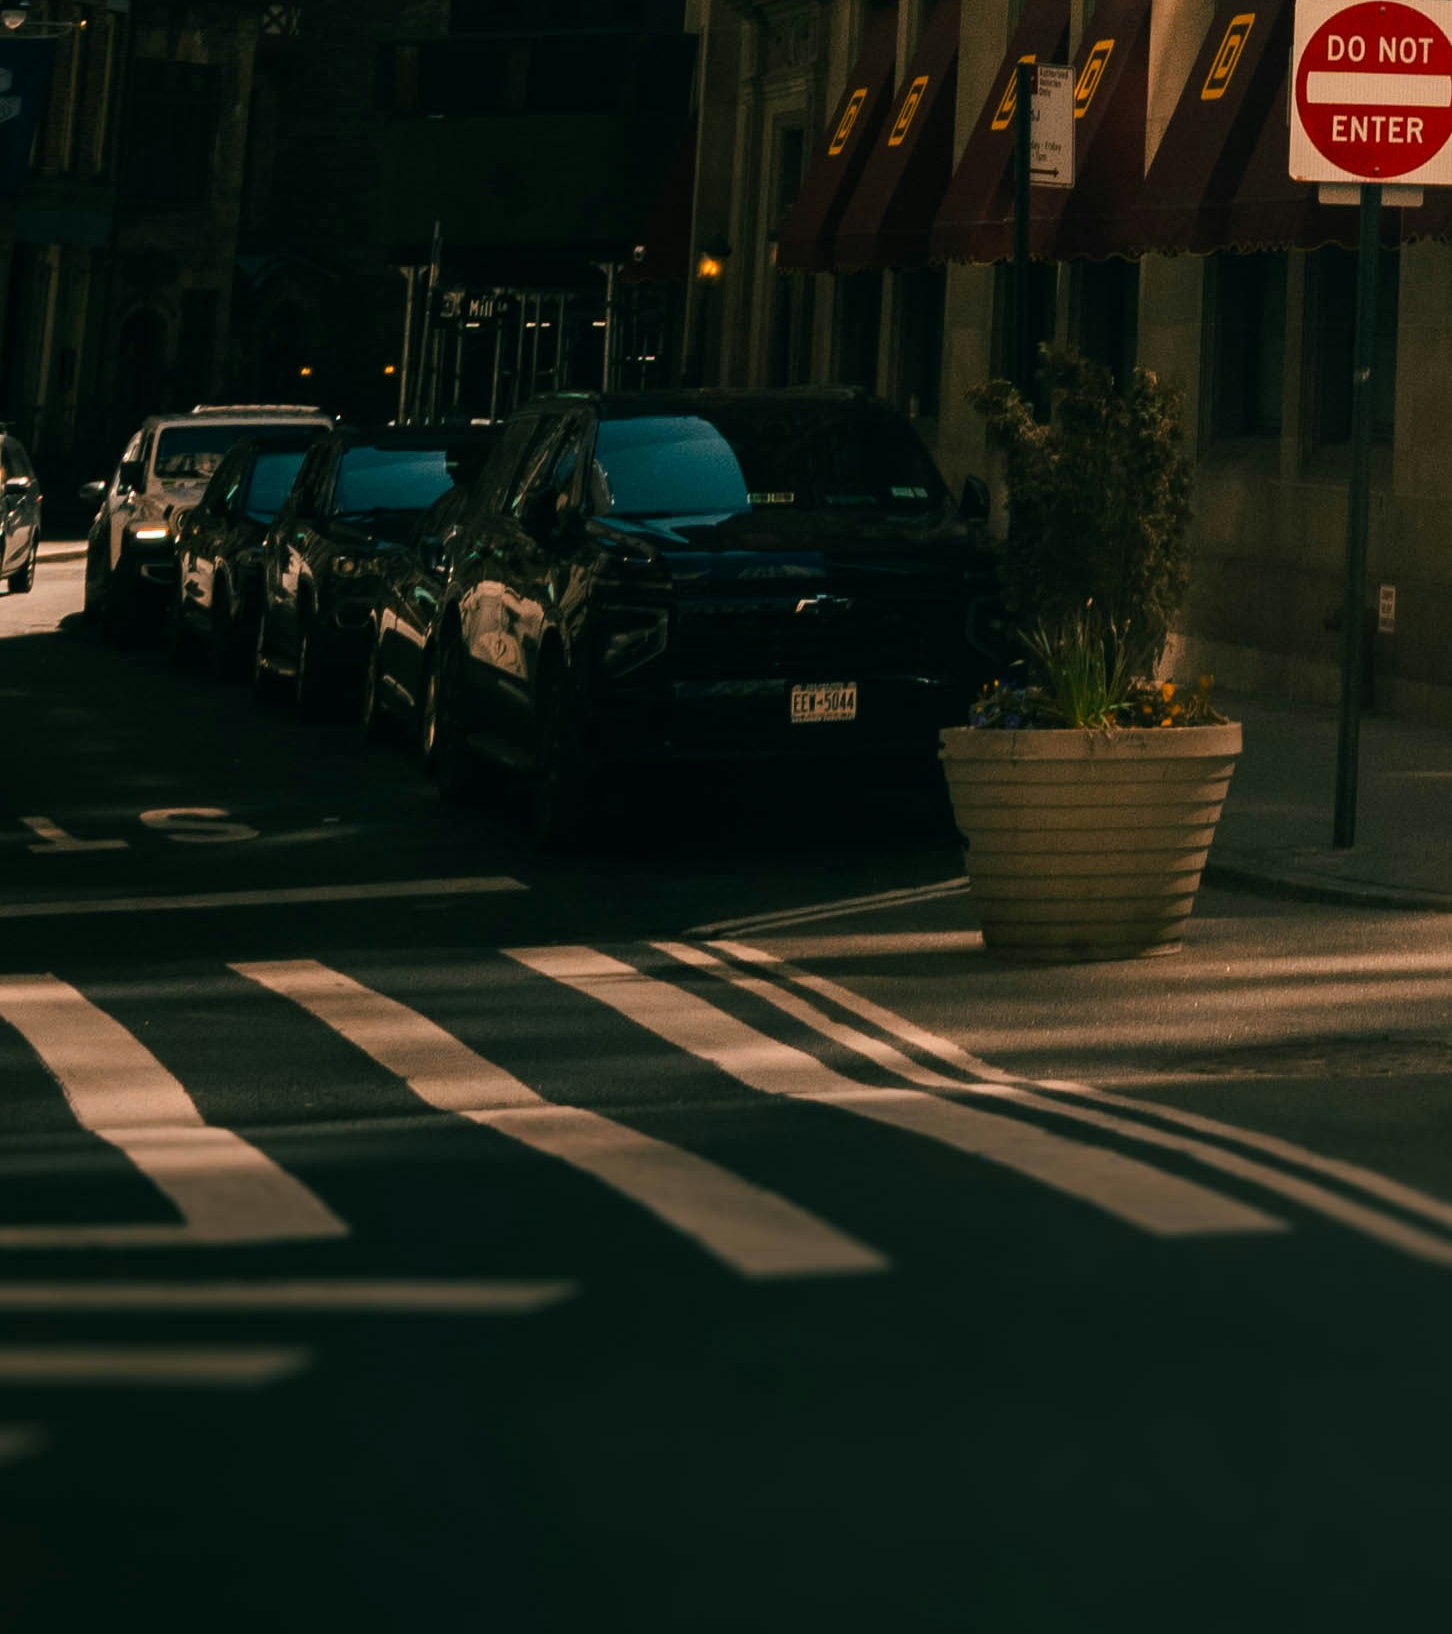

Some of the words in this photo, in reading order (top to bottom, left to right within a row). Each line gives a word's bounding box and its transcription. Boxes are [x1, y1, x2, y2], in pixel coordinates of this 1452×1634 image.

[1327, 34, 1367, 63] DO
[1378, 35, 1434, 65] NOT
[1331, 114, 1424, 144] ENTER
